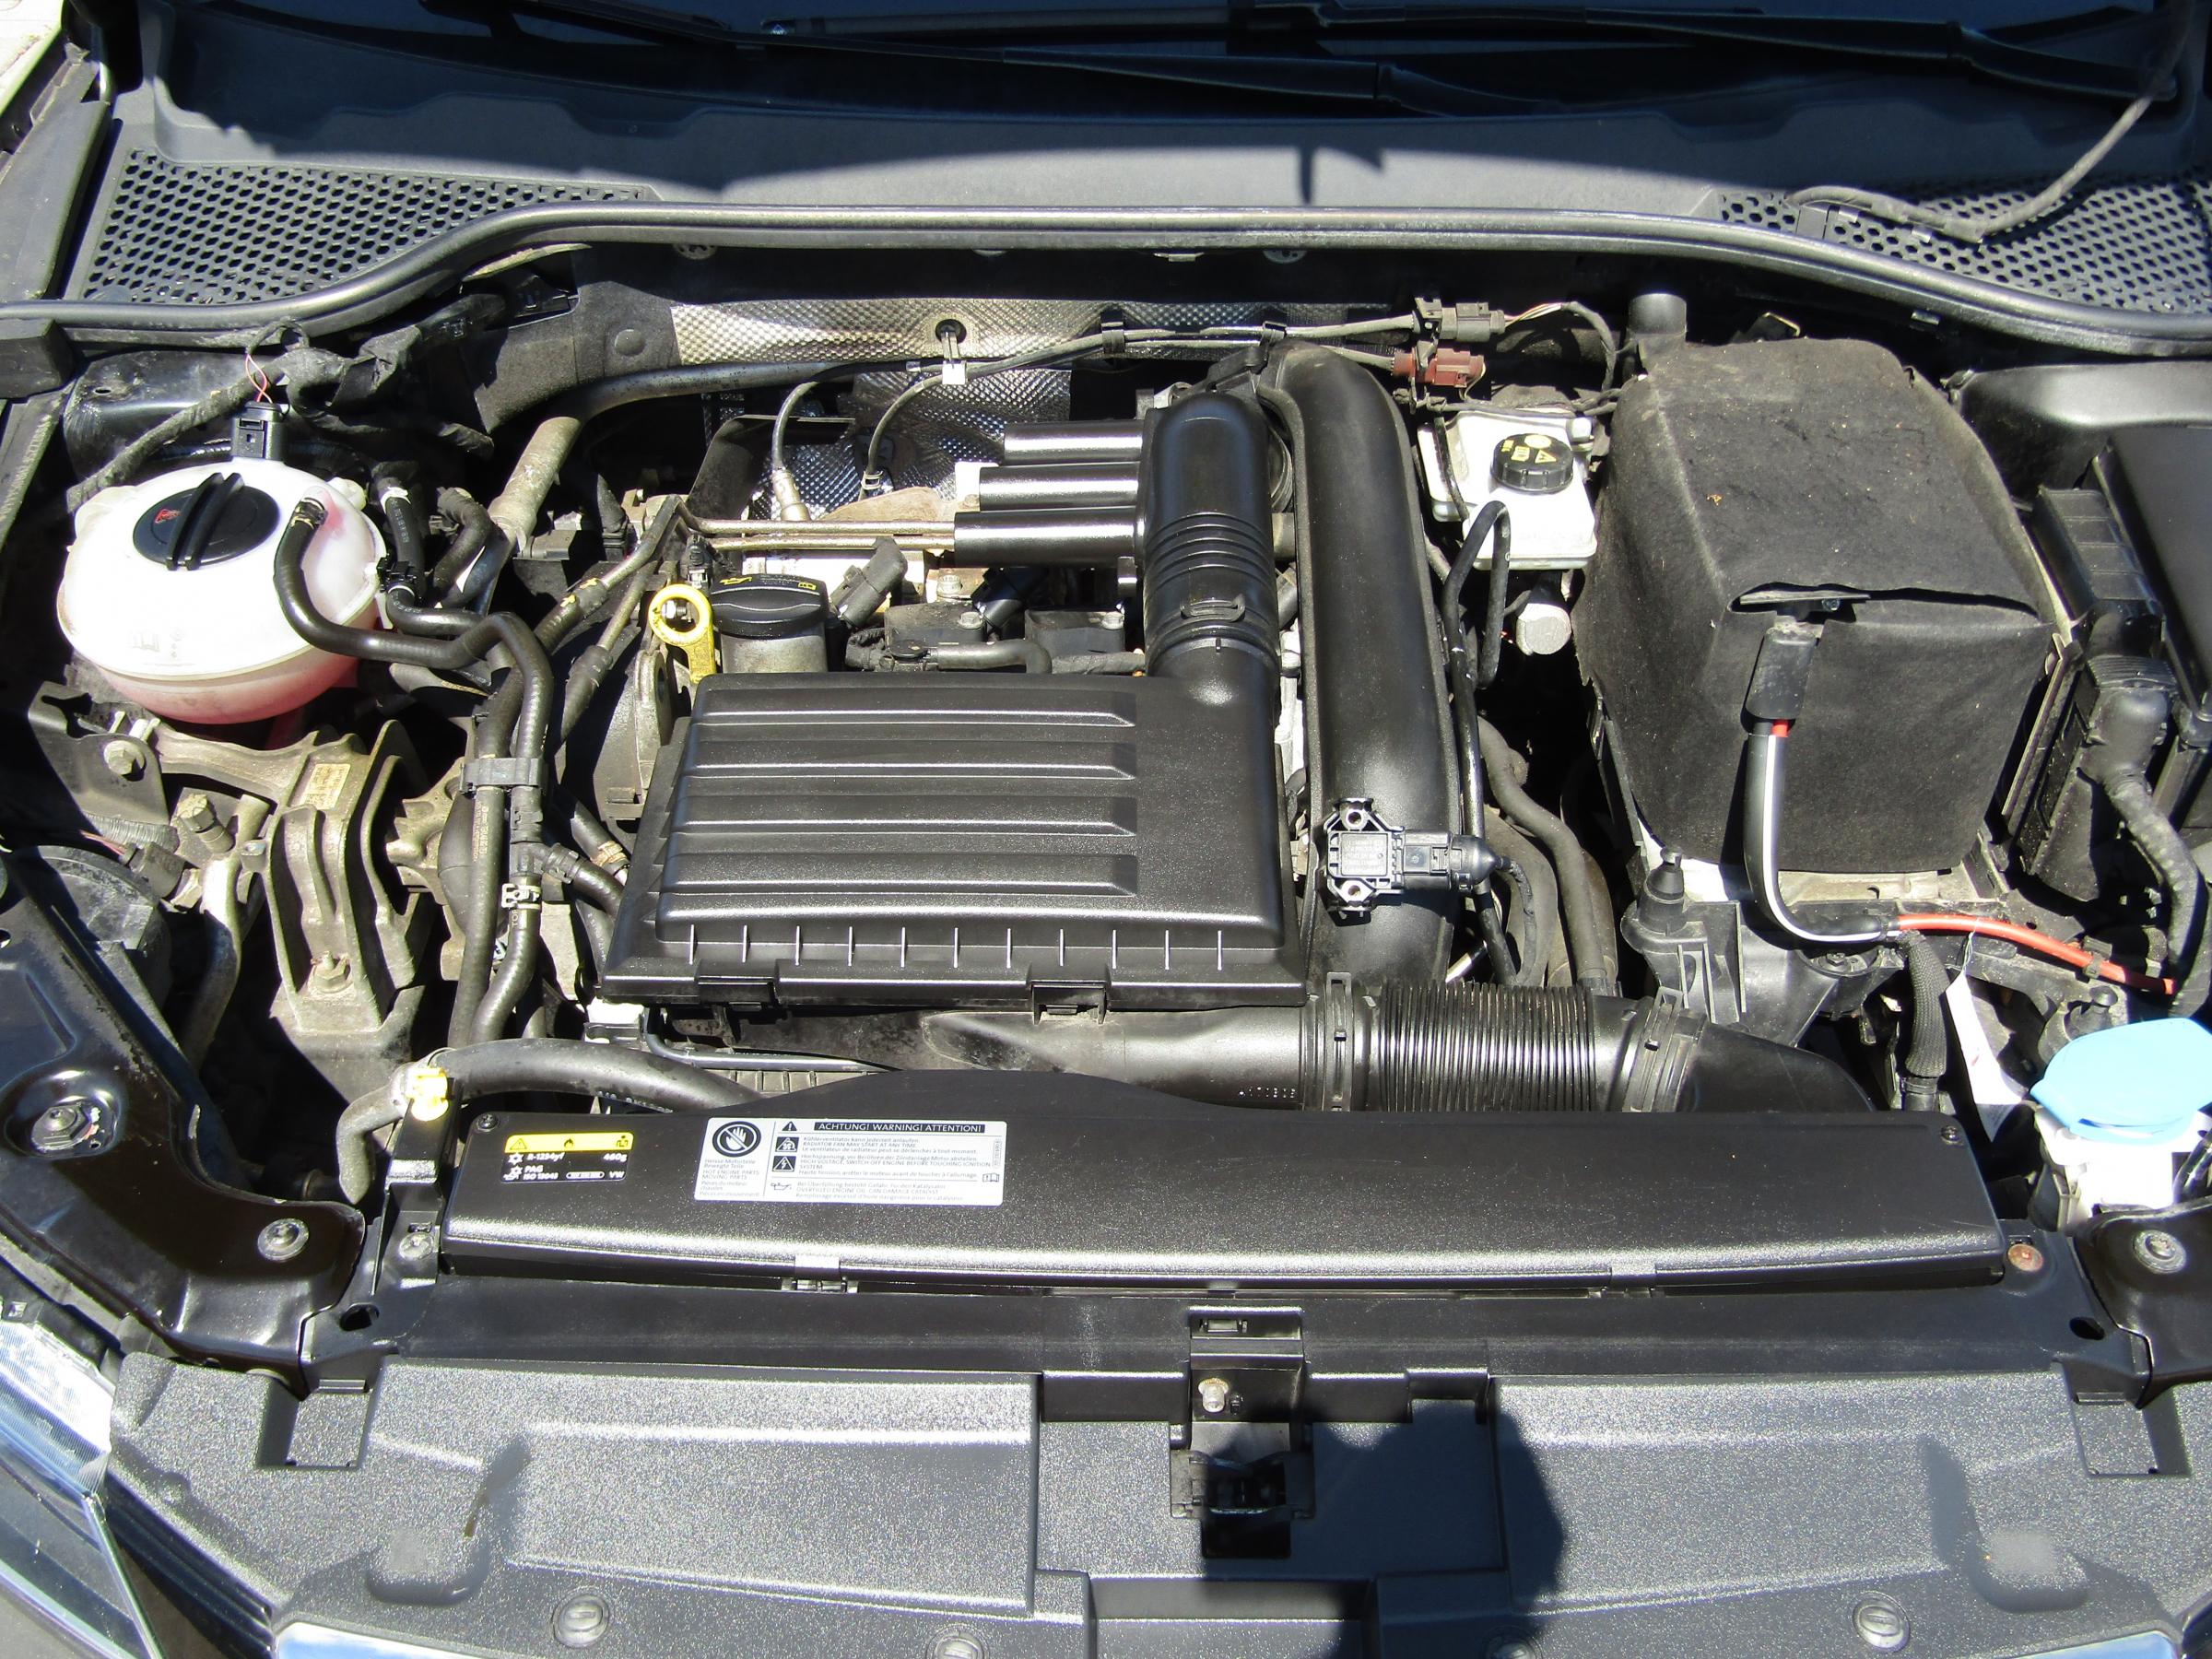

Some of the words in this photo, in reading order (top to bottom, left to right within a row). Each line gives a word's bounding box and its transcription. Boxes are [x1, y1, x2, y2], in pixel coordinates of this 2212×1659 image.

[818, 1123, 871, 1131] ACHTUNG!
[872, 1124, 924, 1132] WARNING!
[924, 1124, 982, 1133] ATTENTION!
[526, 1152, 566, 1162] R-1234yf
[603, 1153, 628, 1162] 460g
[524, 1165, 544, 1173] PAG
[523, 1172, 536, 1181] ISO
